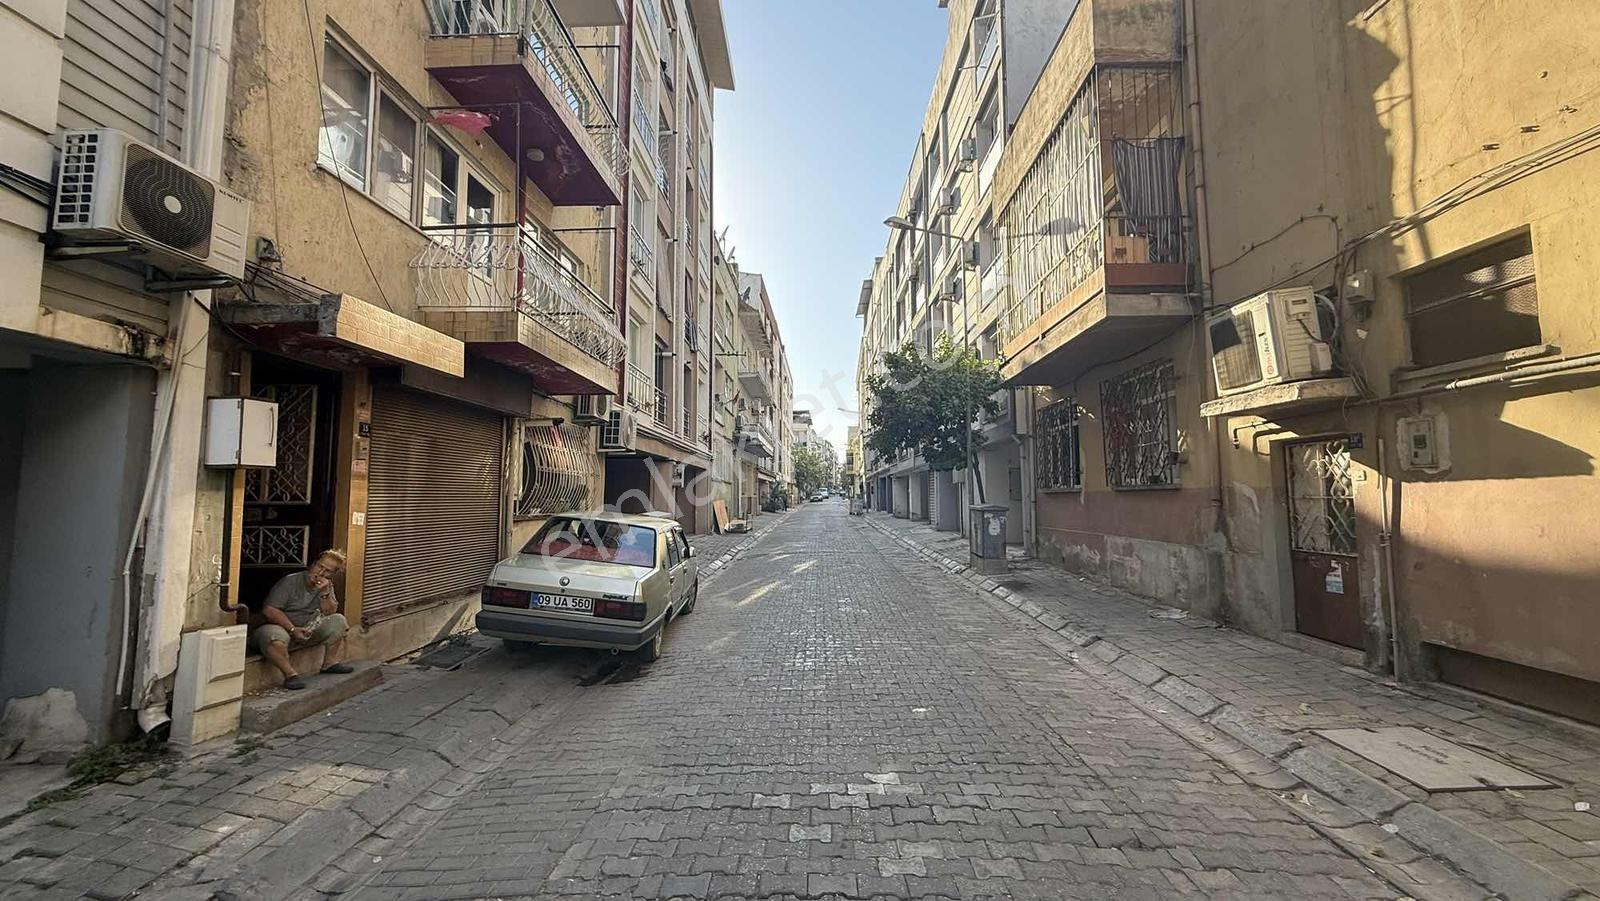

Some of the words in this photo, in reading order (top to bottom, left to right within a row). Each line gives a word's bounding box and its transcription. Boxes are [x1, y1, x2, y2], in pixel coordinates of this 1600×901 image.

[538, 595, 551, 605] 09
[554, 597, 568, 606] UA
[571, 598, 590, 608] 560
